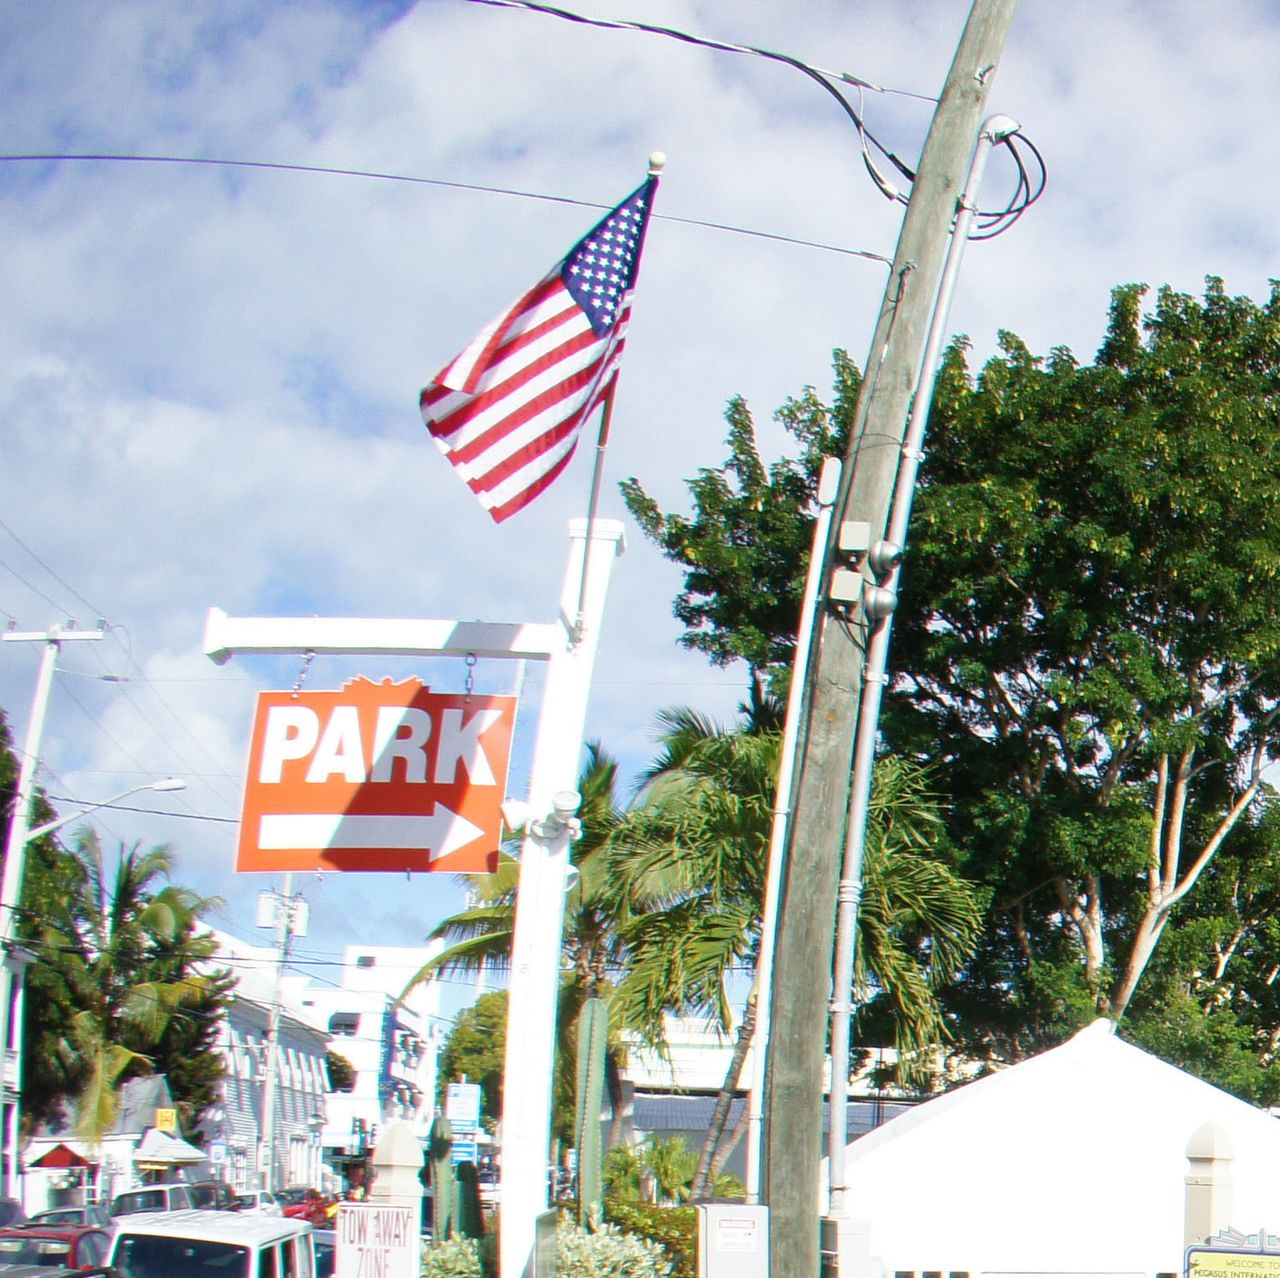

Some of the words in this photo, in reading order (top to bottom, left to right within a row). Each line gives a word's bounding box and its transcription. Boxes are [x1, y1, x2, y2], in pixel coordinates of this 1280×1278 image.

[258, 705, 503, 786] PARK
[340, 1209, 368, 1245] TOW
[374, 1210, 413, 1247] AWAY
[1194, 1269, 1227, 1278] PEGASUS
[1225, 1260, 1265, 1268] WELCOME
[1269, 1262, 1280, 1270] TO
